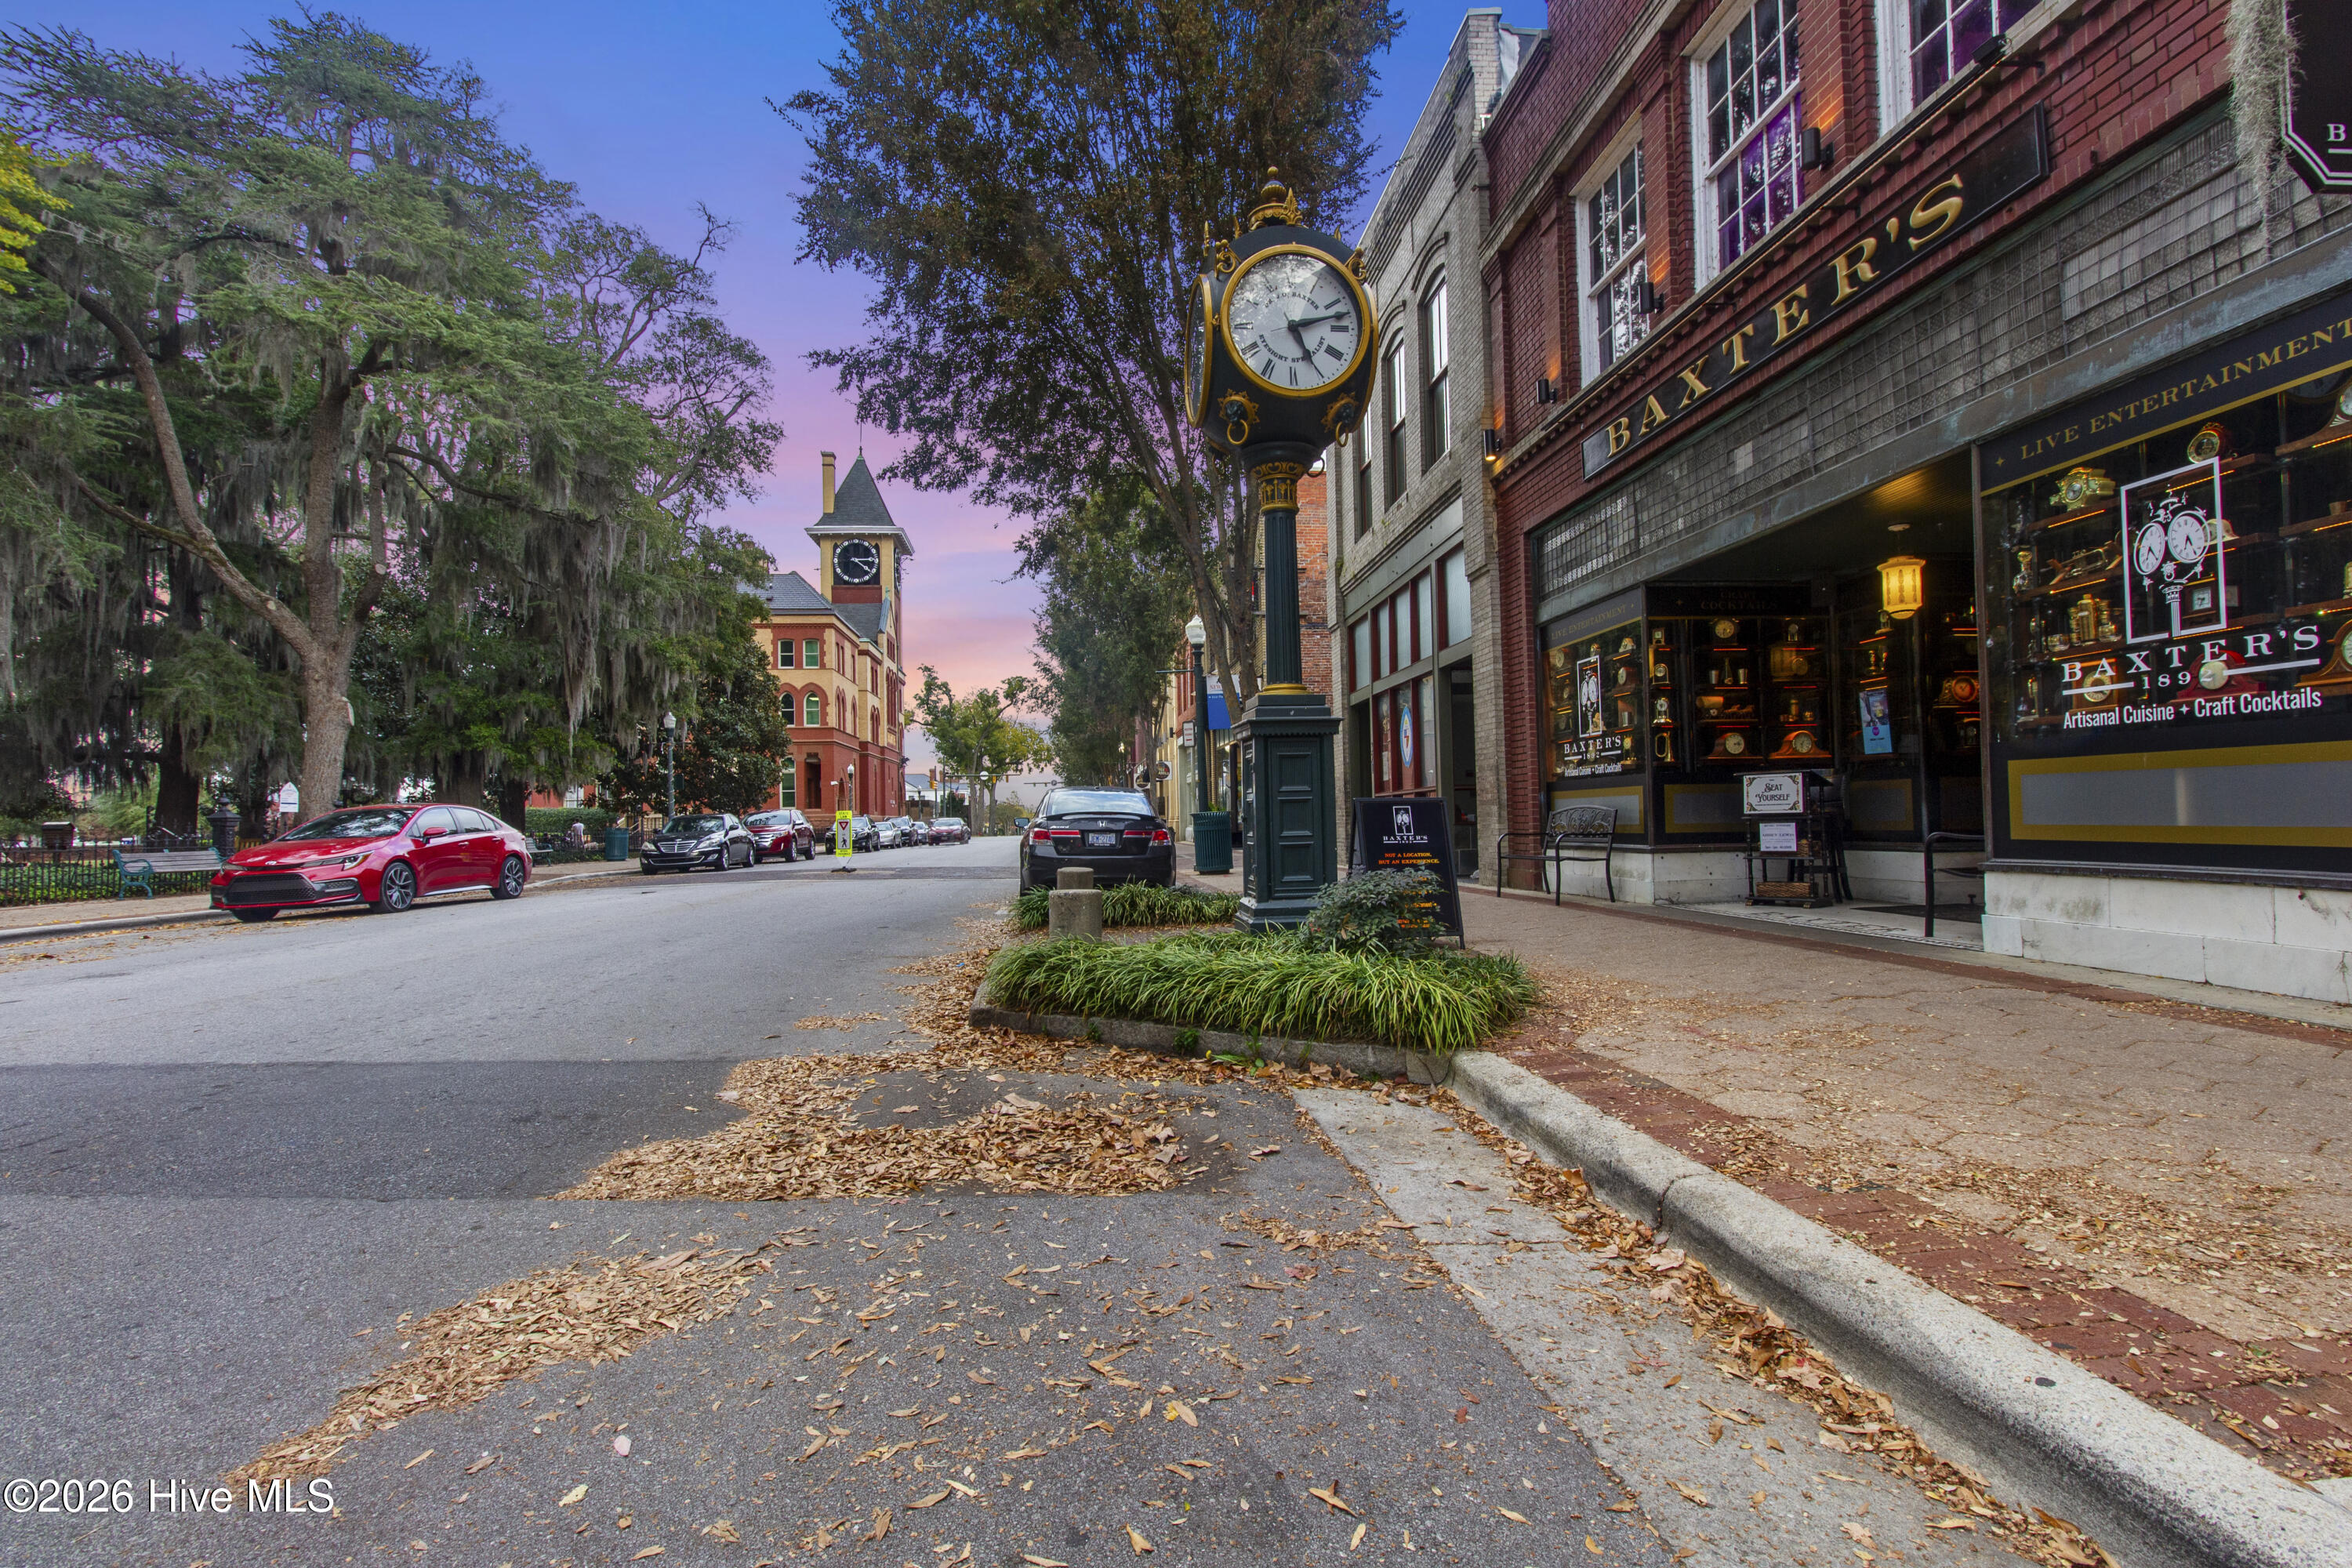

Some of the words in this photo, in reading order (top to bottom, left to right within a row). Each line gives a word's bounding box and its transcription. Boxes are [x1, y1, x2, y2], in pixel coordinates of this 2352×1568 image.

[1291, 292, 1319, 310] BAXTER
[1606, 173, 1963, 458] BAXTER'S
[1258, 333, 1289, 362] EYESIGHT
[1291, 336, 1327, 363] SPEALIST
[2020, 424, 2081, 460] LIVE
[2089, 317, 2352, 434] ENTERTAINMENT
[1552, 626, 1568, 641] LIVE
[1568, 604, 1627, 634] ENTERTAINMENT
[2061, 625, 2321, 683] BAXTER'S
[2142, 670, 2214, 689] 1892
[2063, 706, 2121, 730] Artisanal
[2123, 702, 2176, 724] Cuisine
[2194, 695, 2236, 717] Craft
[2240, 686, 2323, 713] Cocktails
[1563, 735, 1621, 754] BAXTER'S
[1583, 751, 1600, 760] 1892
[1595, 764, 1605, 775] Craft
[1604, 761, 1622, 774] Cocktails
[1762, 782, 1783, 793] SEAT
[1755, 793, 1791, 803] YOURSELF
